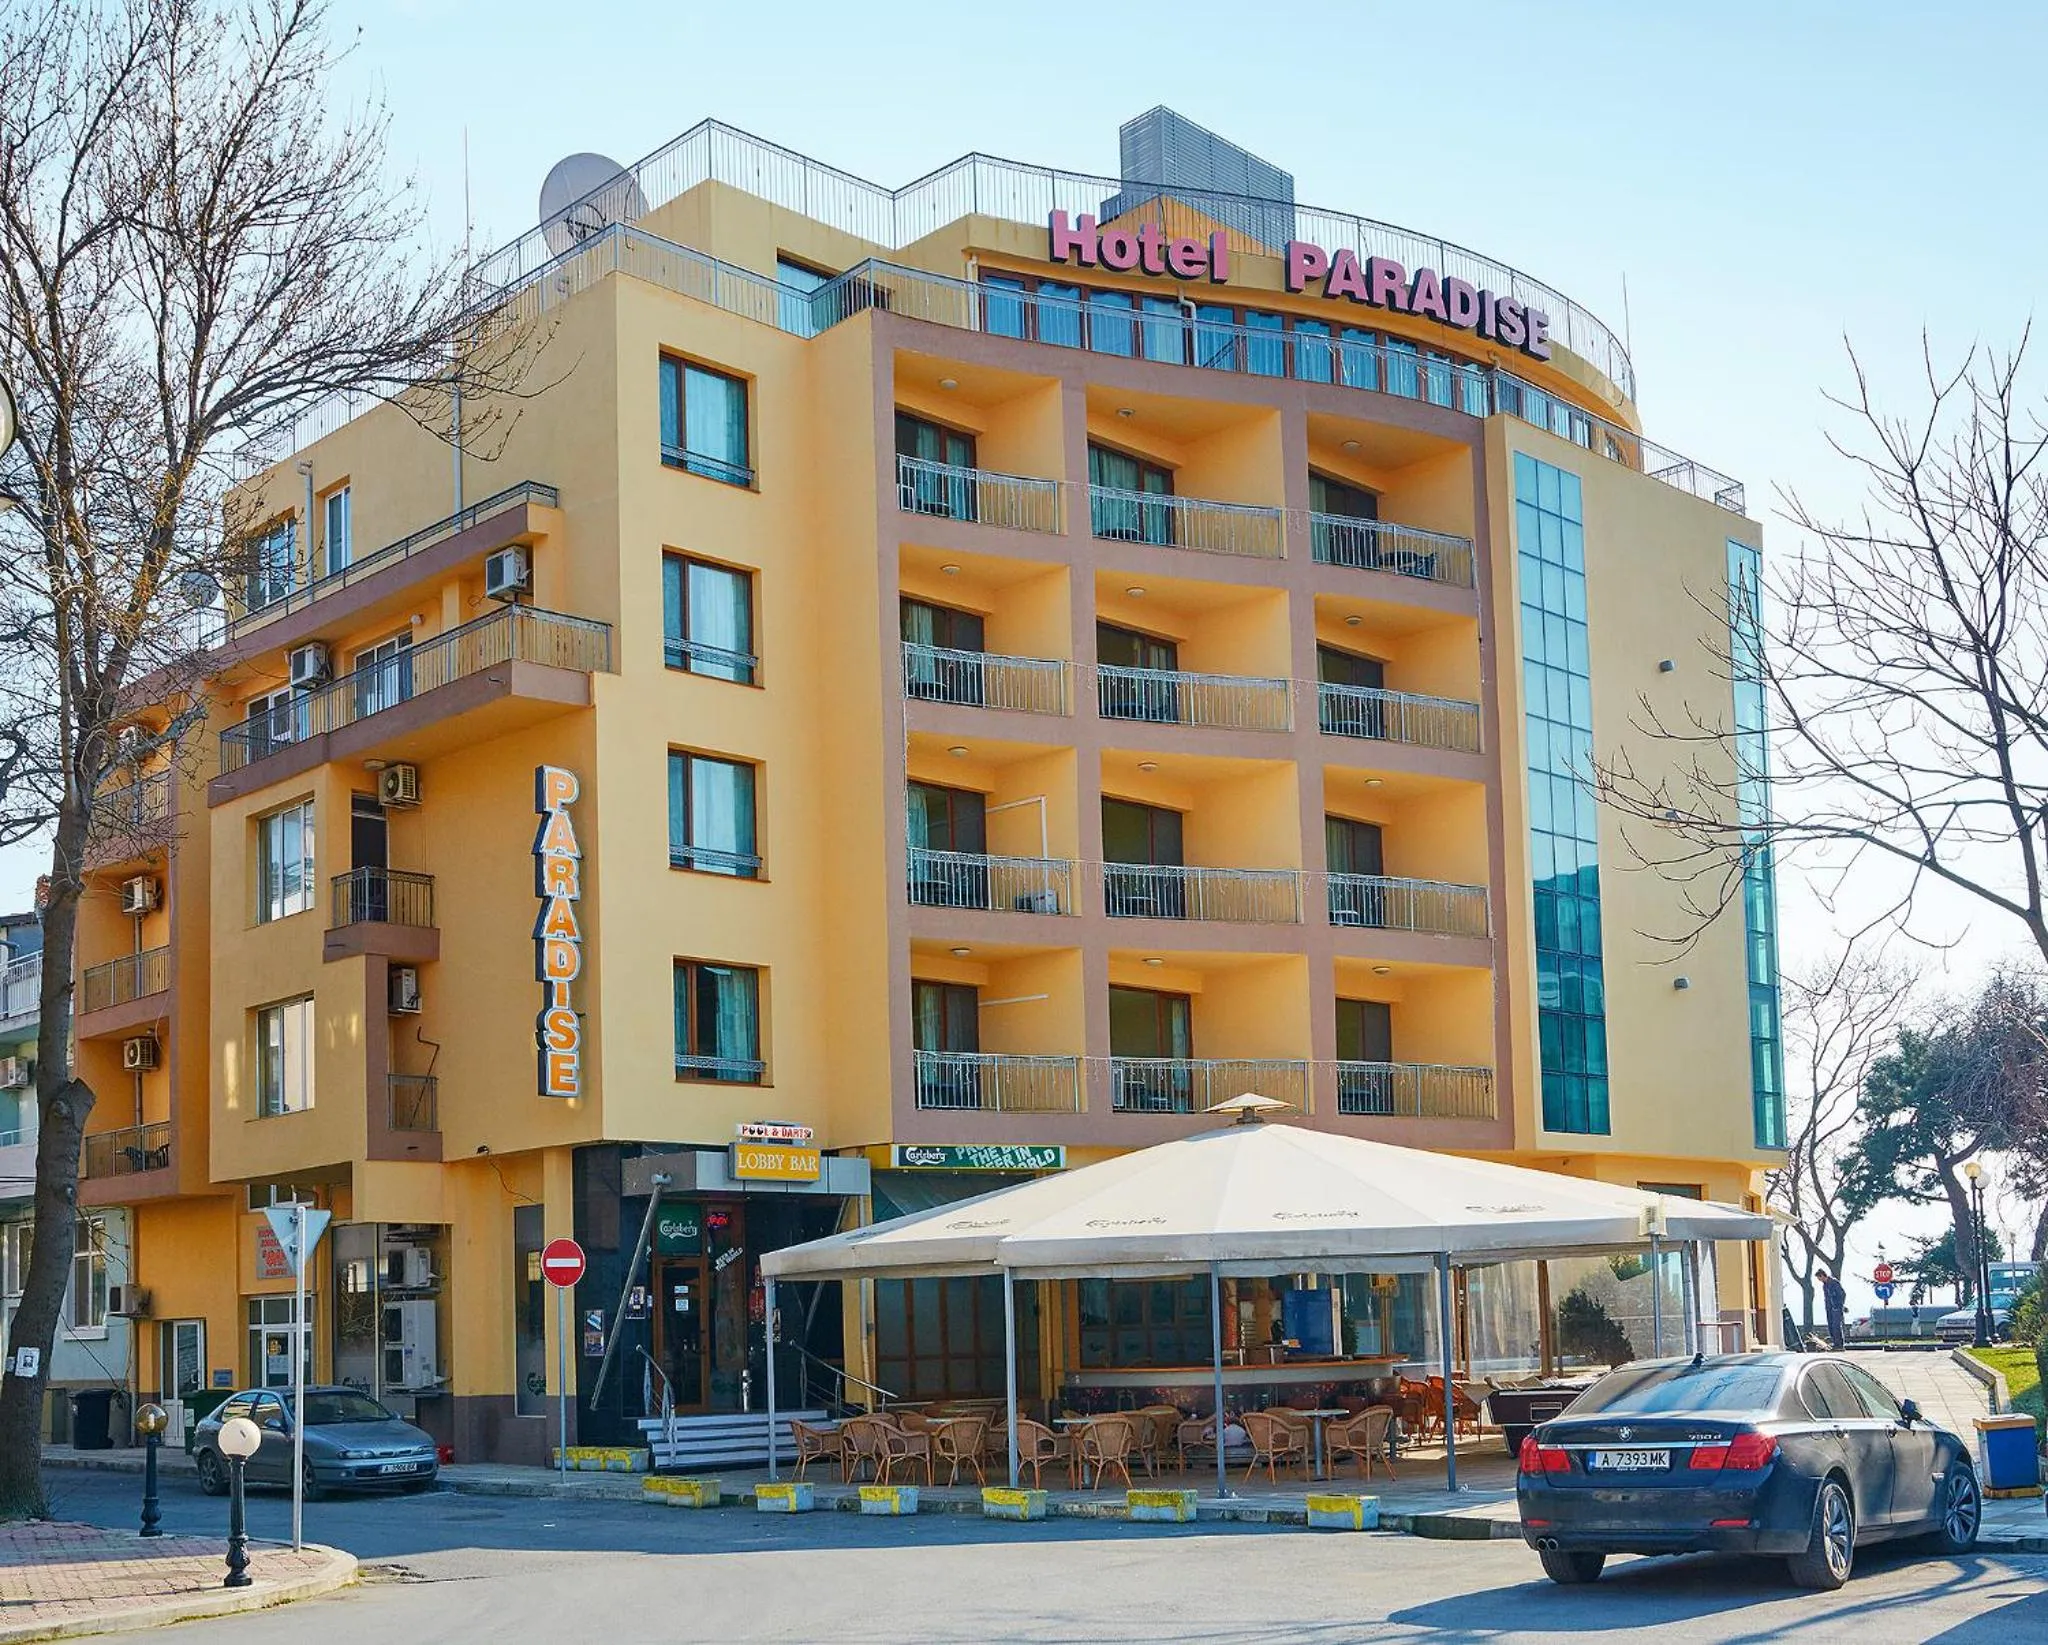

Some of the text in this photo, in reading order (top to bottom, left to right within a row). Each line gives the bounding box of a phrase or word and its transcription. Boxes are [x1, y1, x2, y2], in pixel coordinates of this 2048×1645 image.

[1050, 209, 1552, 361] Hotel PARADISE
[532, 765, 582, 1097] PARADISE
[742, 1125, 811, 1138] POOL & DARTS
[737, 1152, 818, 1172] LOBBY BAR
[905, 1146, 949, 1166] Carlsberg
[968, 1147, 998, 1168] THE
[1014, 1146, 1032, 1162] IN
[660, 1219, 697, 1239] Carlsberg
[1875, 1270, 1891, 1278] STOP
[1601, 1452, 1667, 1466] A 7393 MK
